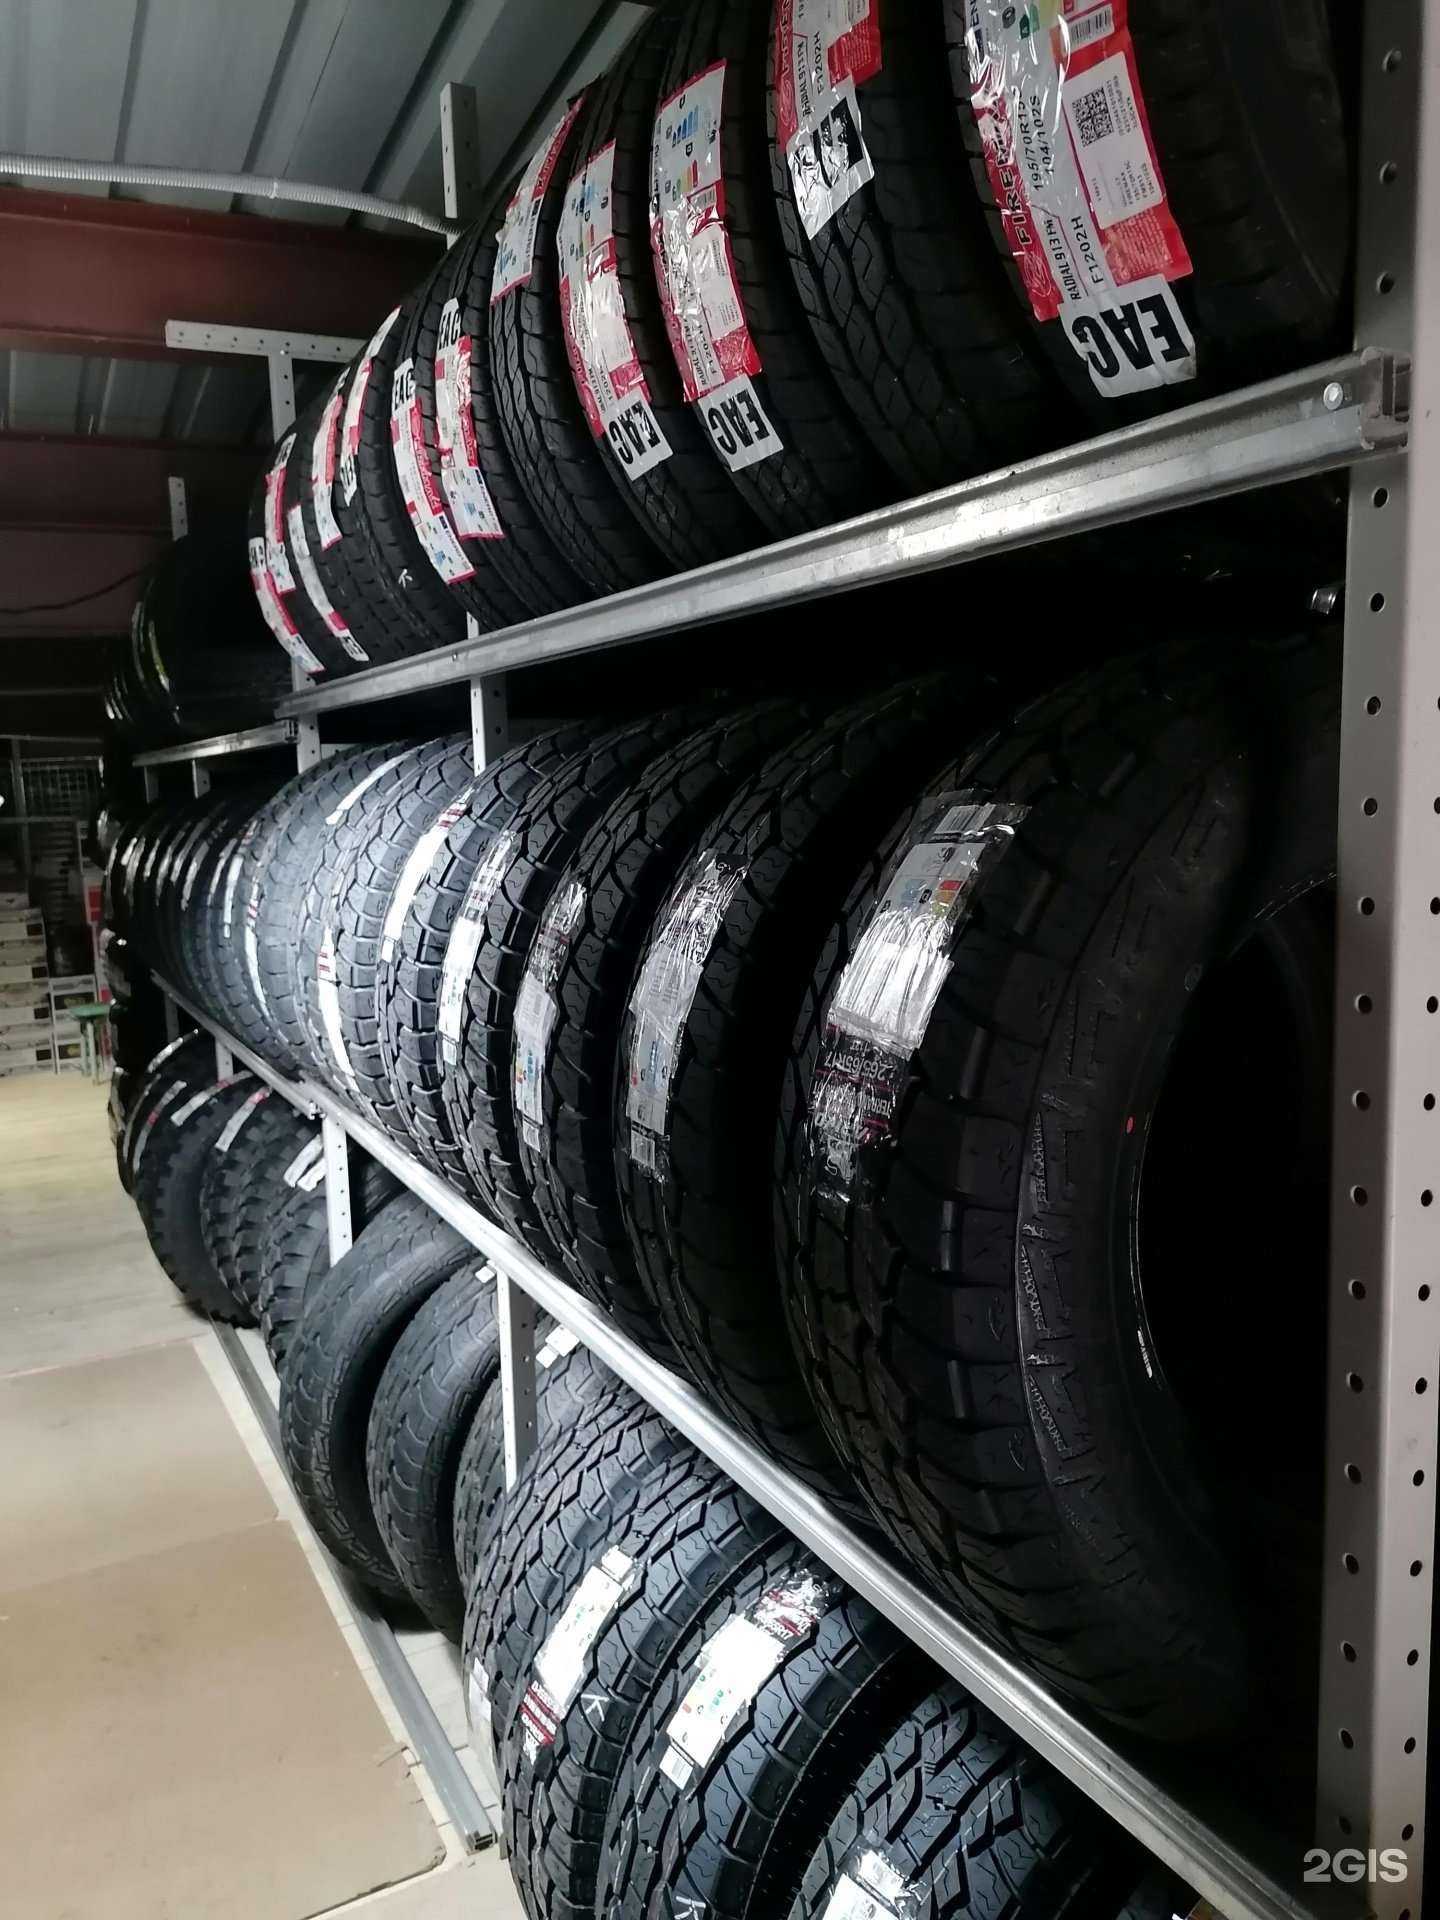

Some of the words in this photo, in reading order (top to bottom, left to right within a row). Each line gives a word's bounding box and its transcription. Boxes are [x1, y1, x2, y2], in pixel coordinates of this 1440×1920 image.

[1058, 263, 1082, 300] RADIAL
[1071, 215, 1104, 284] F1202H
[1072, 294, 1190, 378] EAC
[608, 401, 661, 465] EAC
[708, 389, 770, 455] EAC
